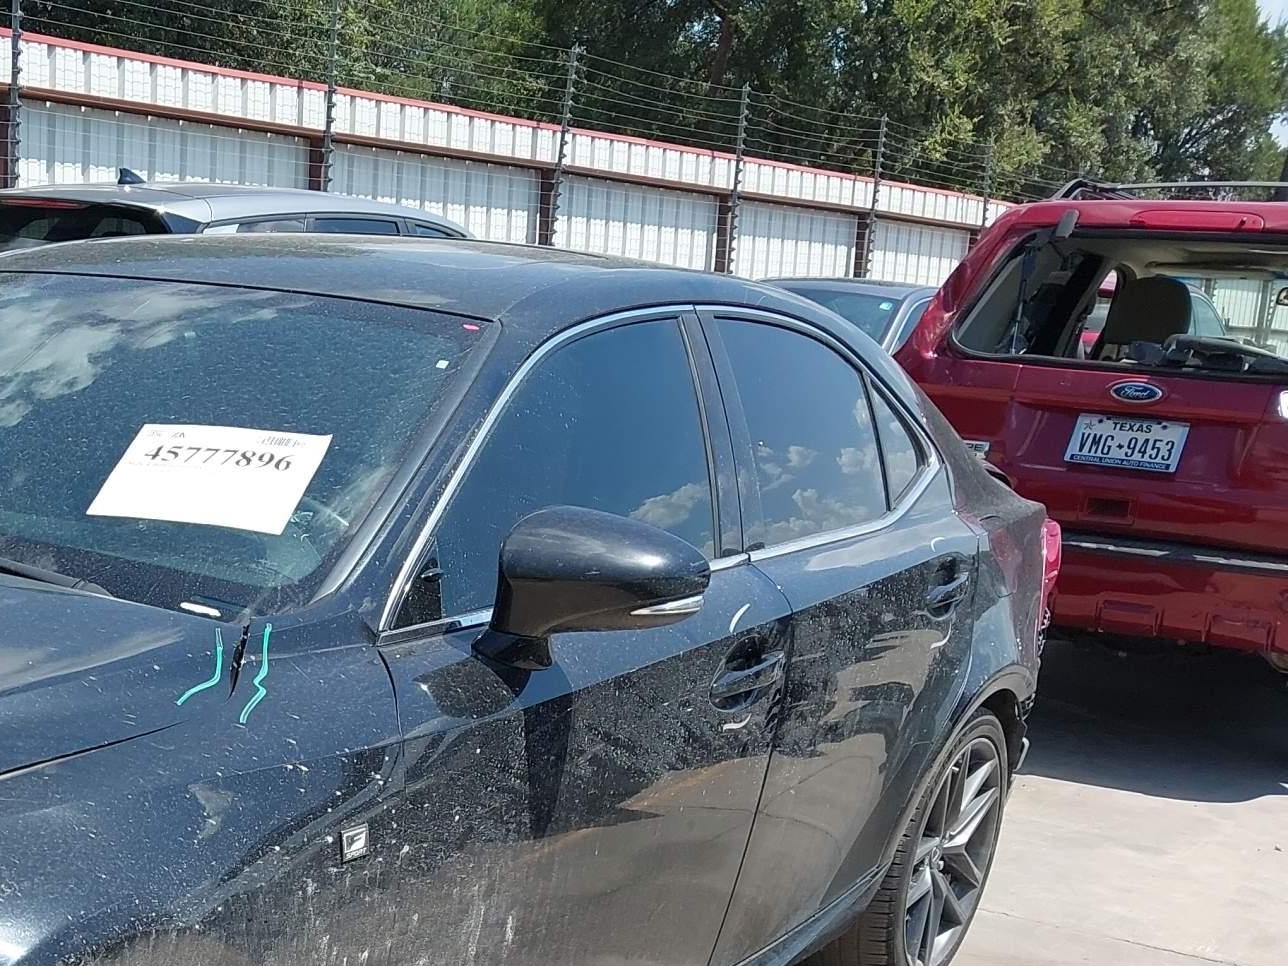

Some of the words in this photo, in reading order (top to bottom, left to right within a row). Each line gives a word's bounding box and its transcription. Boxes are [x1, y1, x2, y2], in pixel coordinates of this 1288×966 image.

[1121, 385, 1150, 399] Ford
[1112, 421, 1153, 434] TEXAS
[144, 444, 296, 472] 45777896
[1073, 454, 1101, 463] CENTRAL
[1101, 457, 1122, 465] UNION
[1123, 459, 1139, 467] AUTO
[1139, 461, 1166, 470] FINANCE
[345, 847, 367, 859] SPORT
